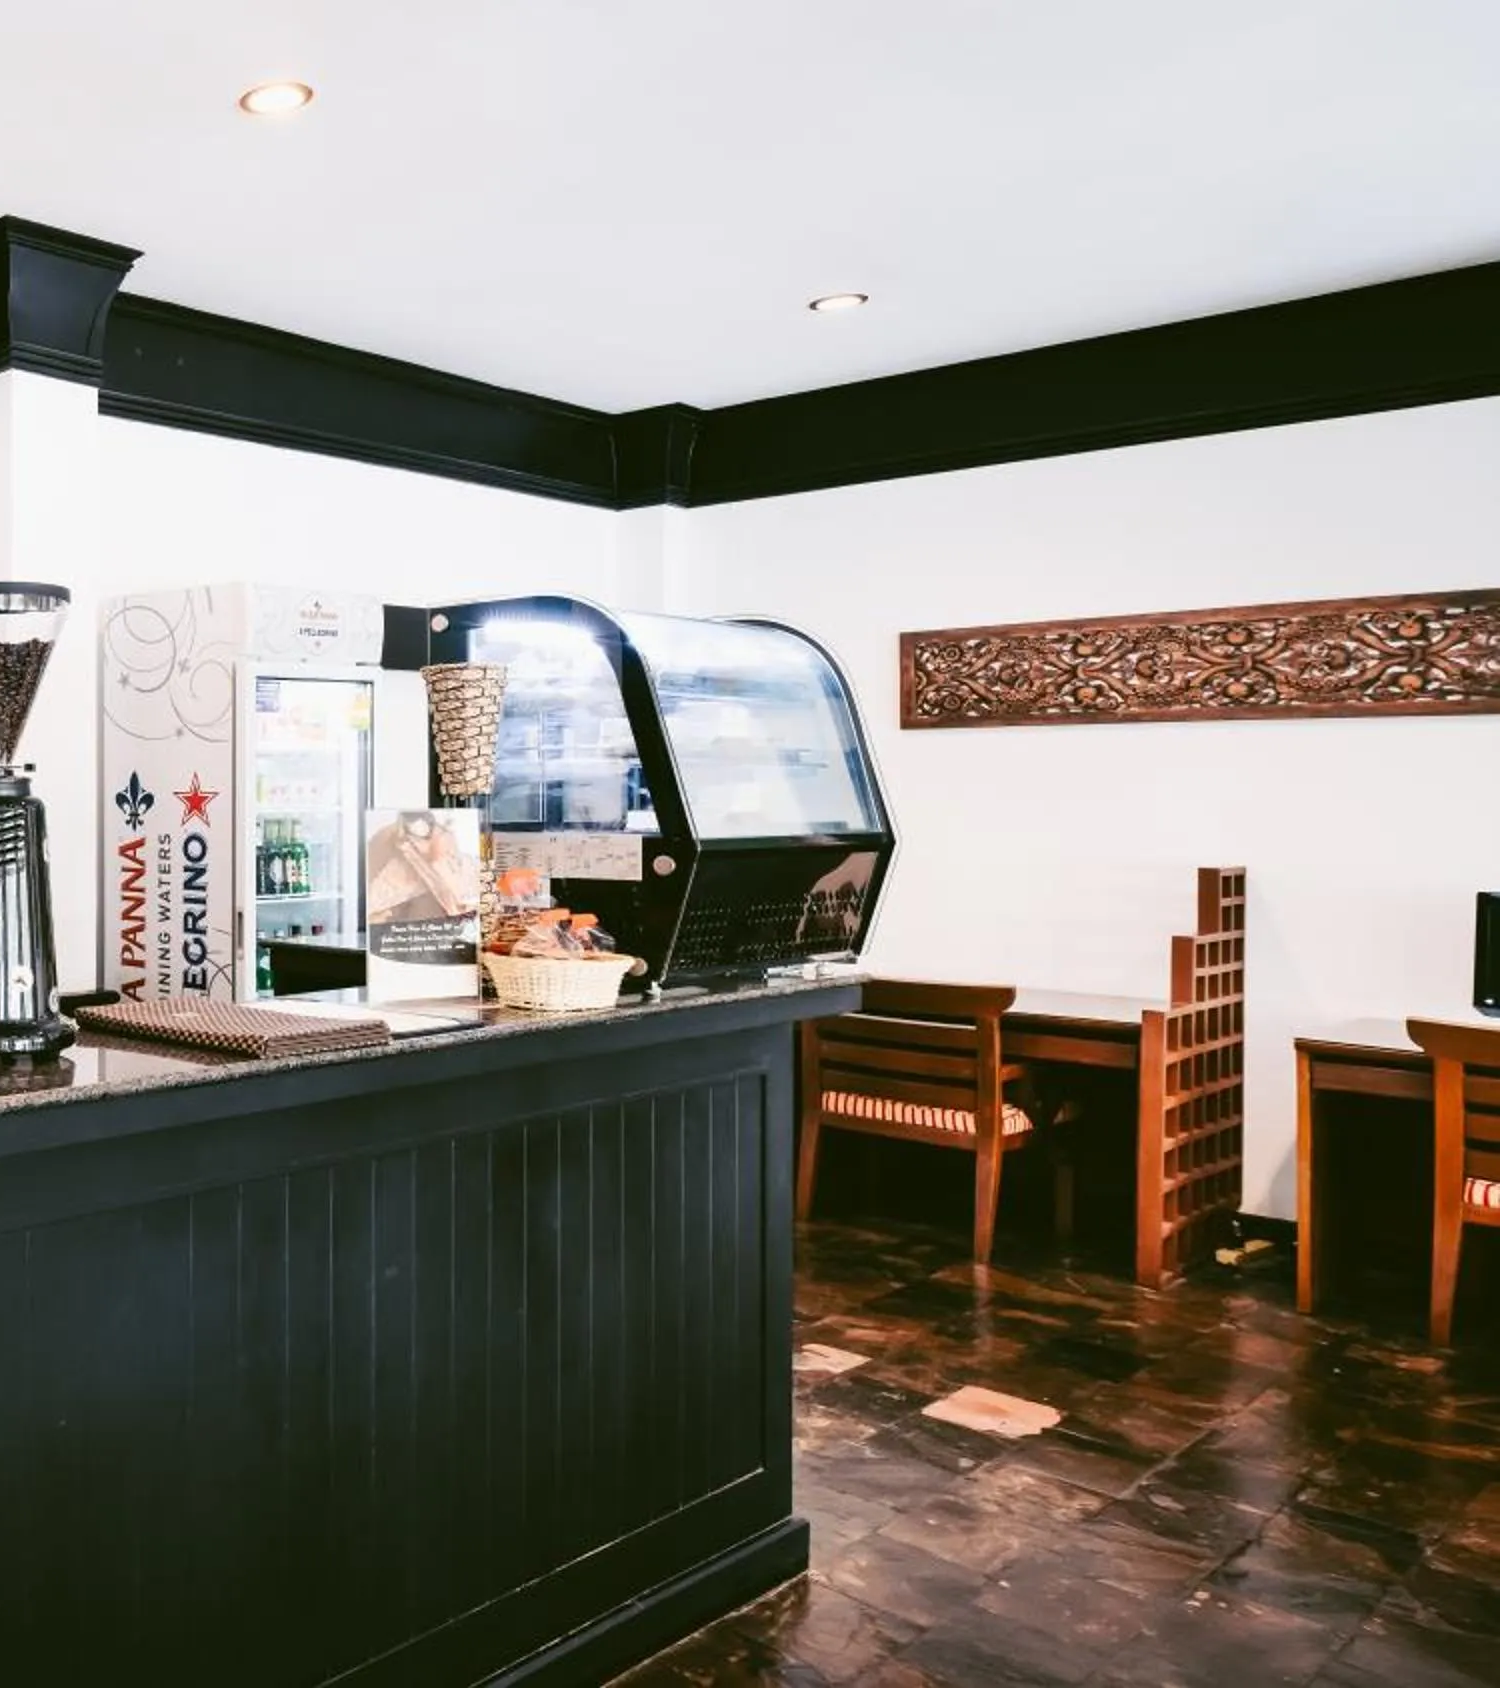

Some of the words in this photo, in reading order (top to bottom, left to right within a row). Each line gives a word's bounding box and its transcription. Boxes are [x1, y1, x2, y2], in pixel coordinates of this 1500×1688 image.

[118, 836, 146, 969] PANNA
[158, 833, 171, 922] WATERS
[182, 832, 207, 996] EGRINO
